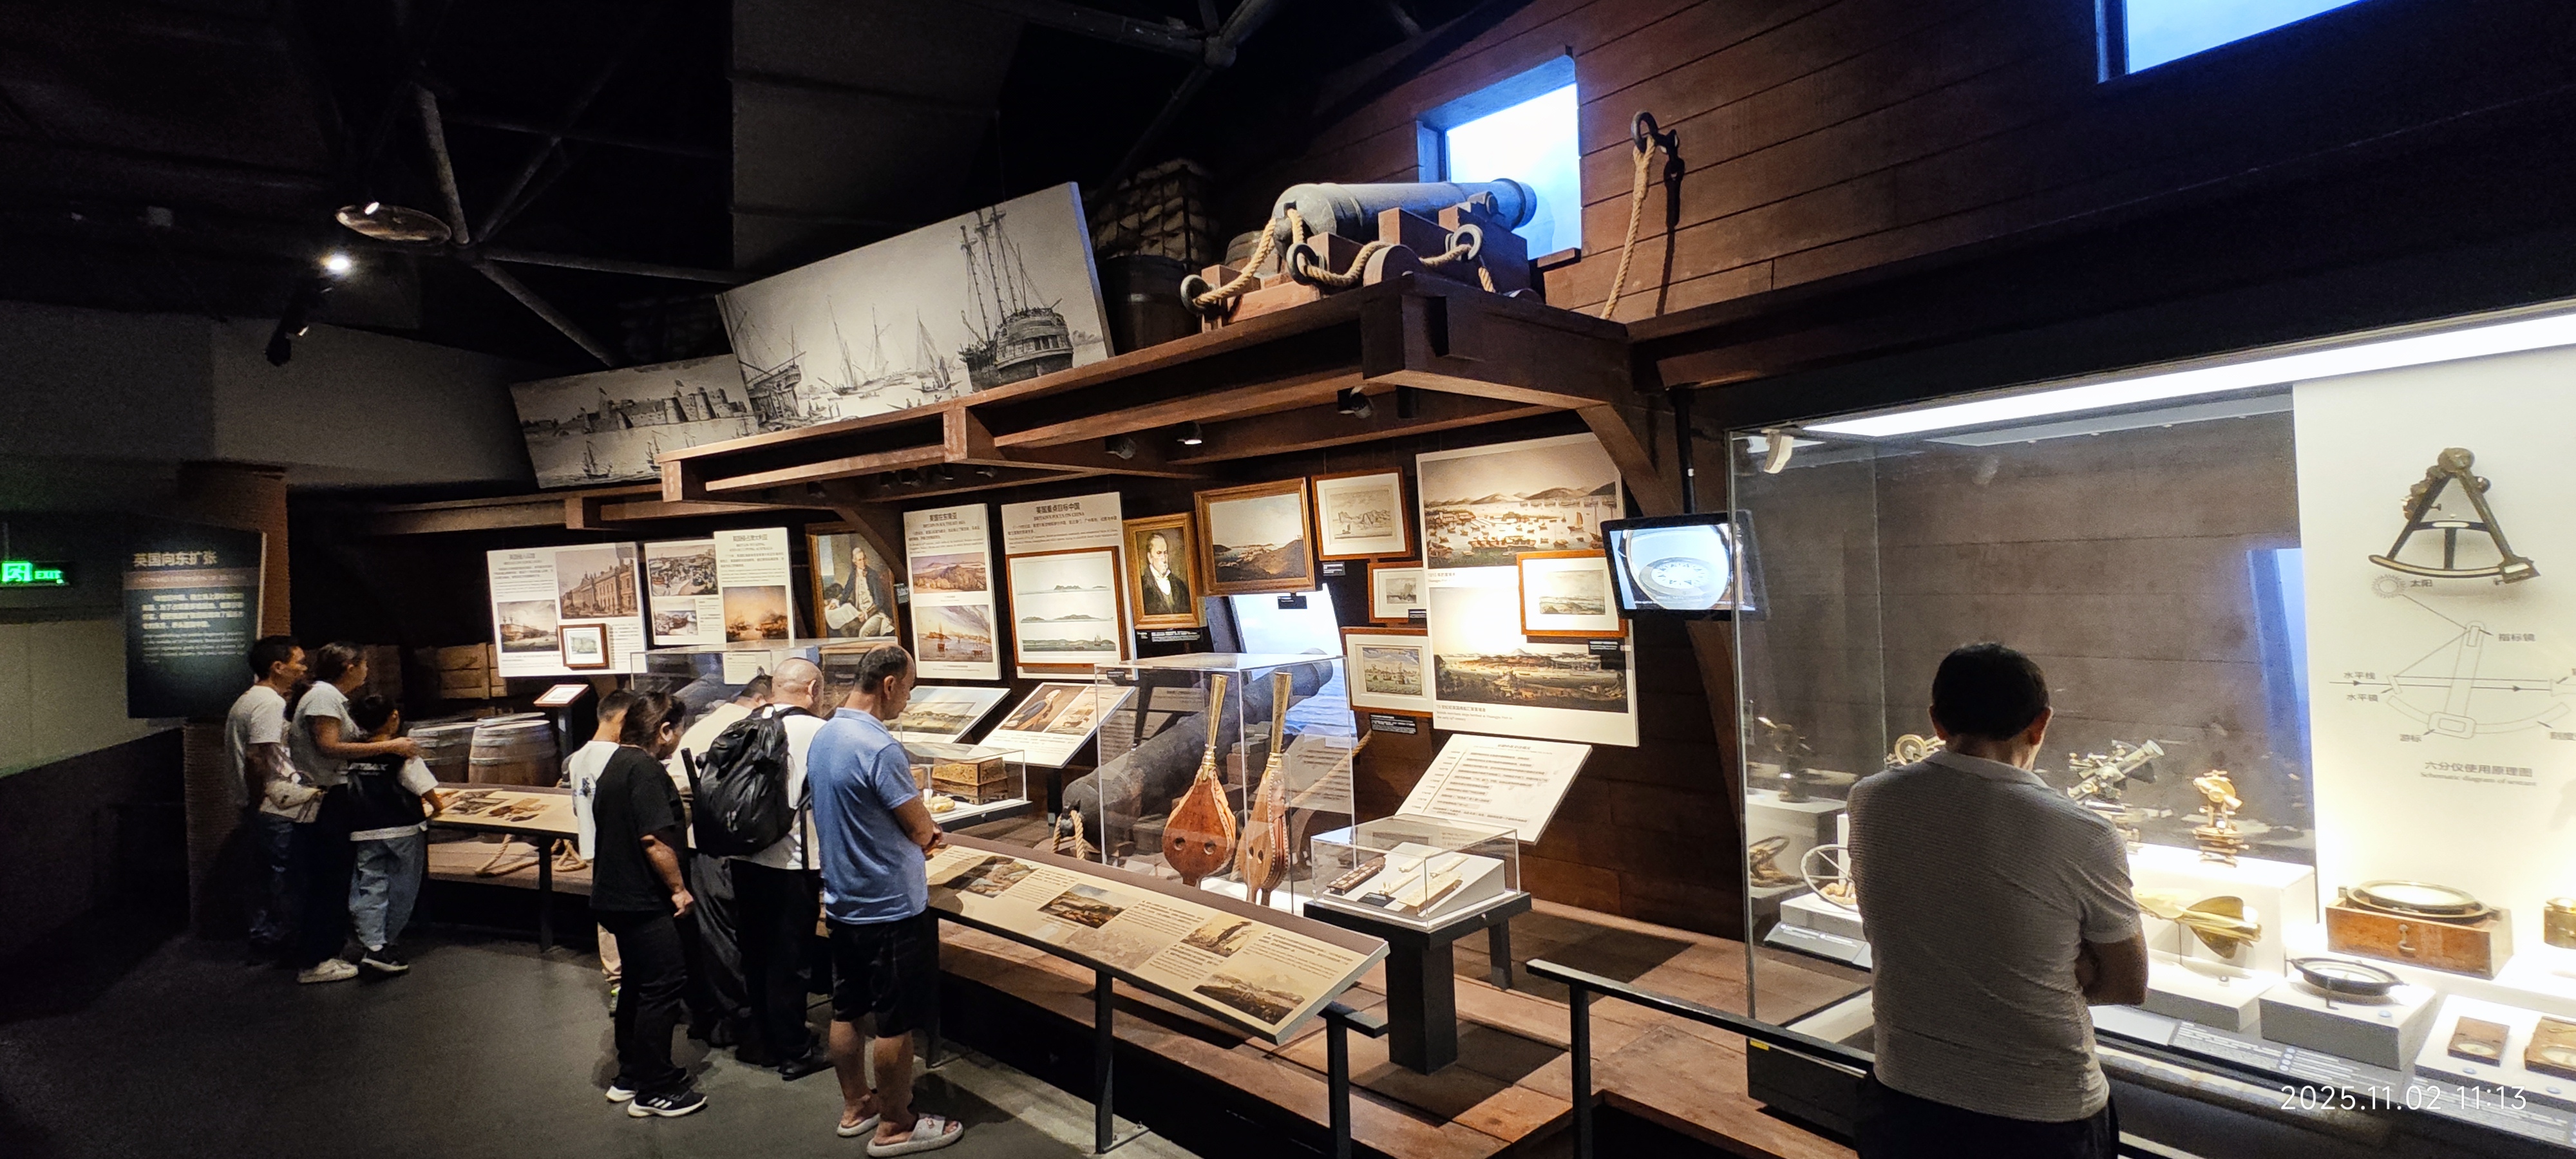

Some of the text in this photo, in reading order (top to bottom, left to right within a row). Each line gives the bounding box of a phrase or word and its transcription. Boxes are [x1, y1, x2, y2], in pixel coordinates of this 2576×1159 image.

[133, 551, 218, 567] 英国向东扩张
[35, 570, 62, 579] EXIT
[2410, 579, 2432, 587] 太阳
[2499, 634, 2535, 642] 指标镜
[2347, 693, 2378, 702] 水平镜
[2550, 731, 2576, 740] 刻度
[2425, 762, 2532, 777] 六分仪使用原理图
[2420, 772, 2460, 780] Schematic
